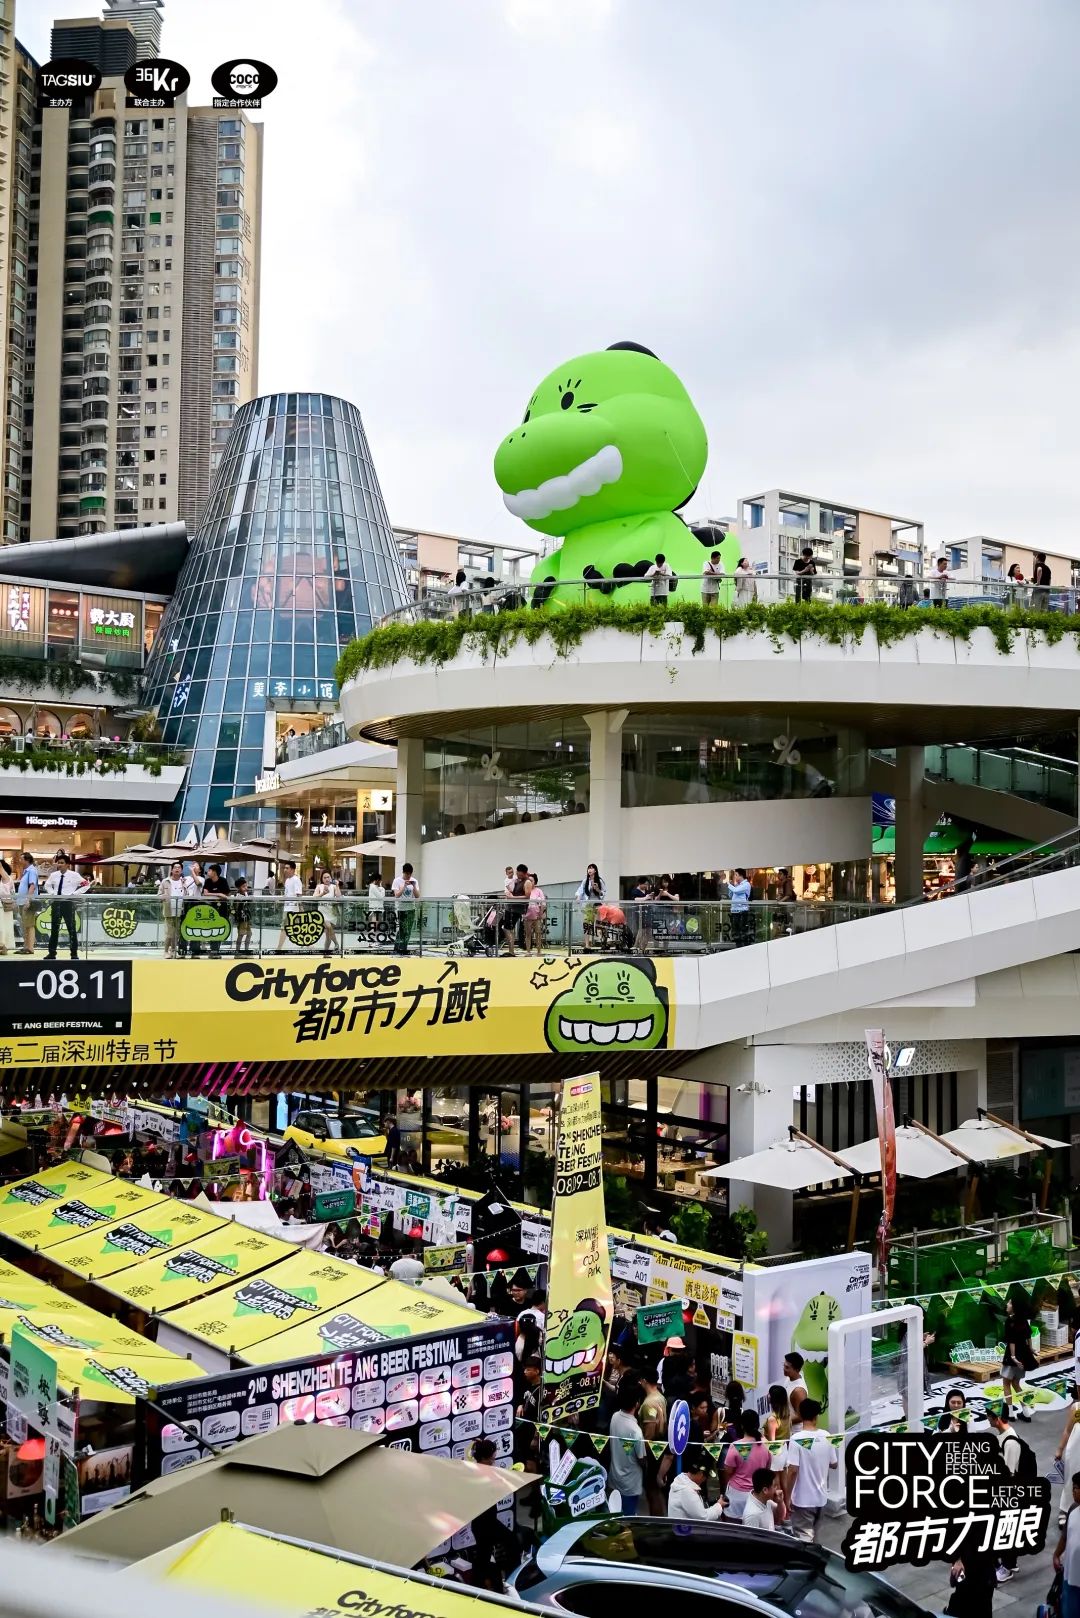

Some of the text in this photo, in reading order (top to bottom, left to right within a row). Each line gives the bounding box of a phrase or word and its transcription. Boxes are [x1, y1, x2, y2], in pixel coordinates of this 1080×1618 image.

[103, 907, 136, 920] CITY
[103, 918, 137, 929] FORCE
[106, 928, 133, 938] 2024
[225, 962, 401, 1004] Cityforce
[292, 978, 491, 1043] 都市力酿
[0, 1038, 178, 1065] 第二届深圳特昂节
[572, 1124, 600, 1142] SHENZHE
[577, 1152, 600, 1169] FESTIV
[457, 1221, 469, 1231] A23
[540, 1243, 549, 1253] A0
[634, 1271, 648, 1283] A01
[248, 1279, 276, 1296] CITY
[685, 1278, 719, 1305] 酒鬼诊所
[333, 1313, 391, 1342] CITY FORC
[248, 1376, 268, 1405] 2ND
[271, 1363, 336, 1400] SHENZHEN
[336, 1360, 353, 1385] TE
[354, 1354, 379, 1382] ANG
[380, 1347, 410, 1376] BEER
[411, 1336, 463, 1370] FESTIVAL
